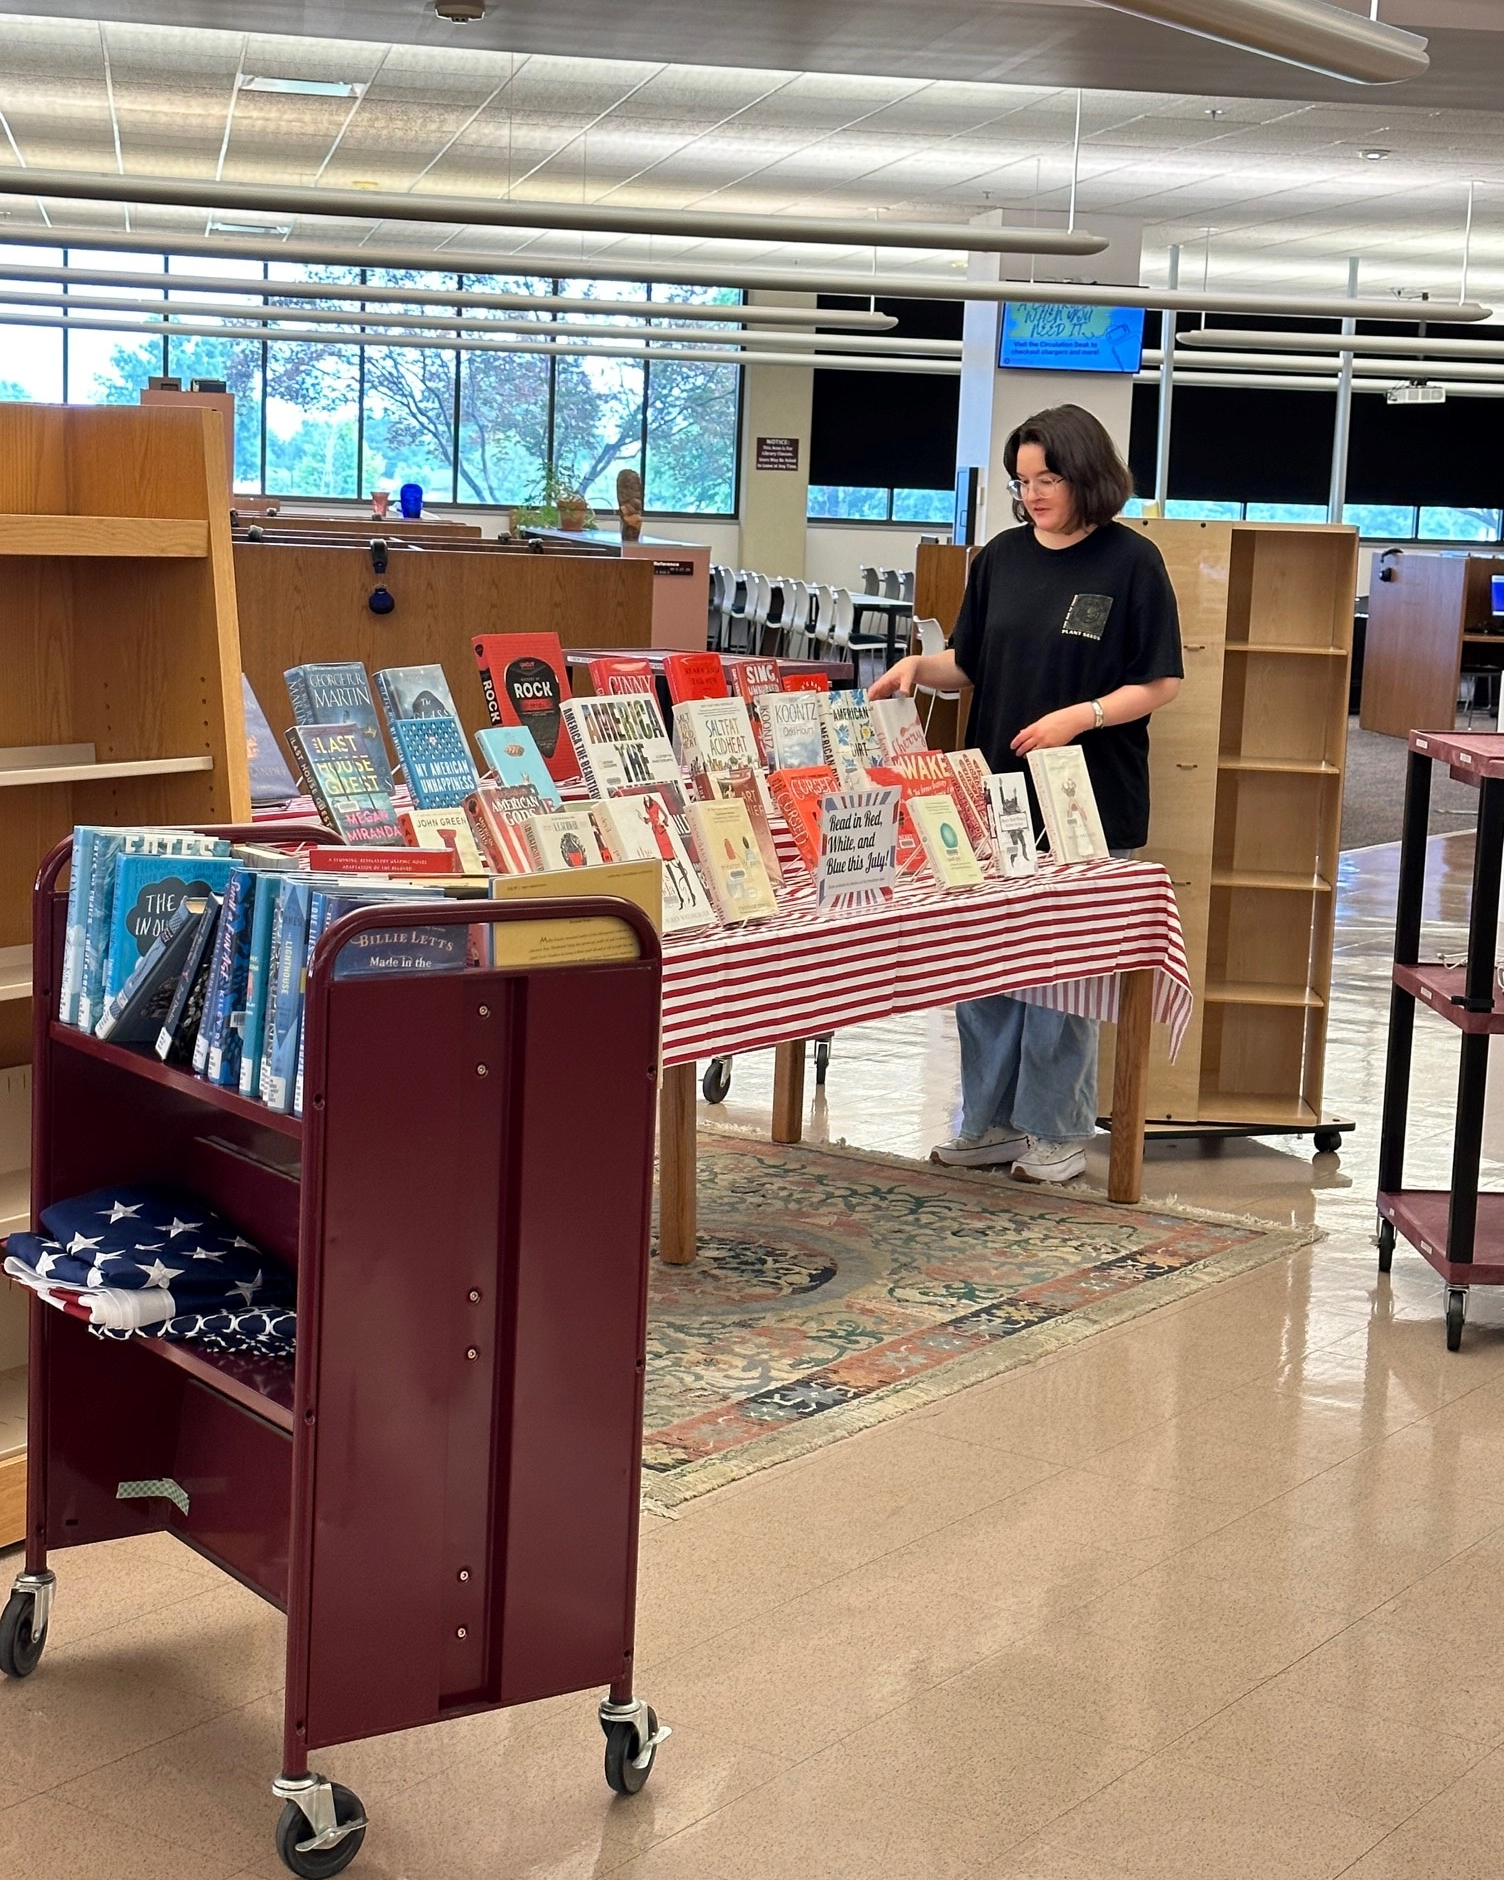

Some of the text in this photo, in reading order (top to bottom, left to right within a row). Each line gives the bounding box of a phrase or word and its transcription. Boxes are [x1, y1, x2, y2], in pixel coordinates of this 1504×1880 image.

[1031, 322, 1083, 338] NEED IT
[1061, 628, 1101, 641] PLANT SEEDS
[309, 674, 345, 687] GEORGE
[513, 681, 553, 699] ROCK
[288, 680, 306, 725] MARTIN
[313, 686, 371, 708] MARTIN
[483, 679, 501, 723] ROCK
[581, 700, 665, 744] AMERICA
[775, 702, 818, 723] KOONTZ
[832, 706, 869, 721] AMERICAN
[705, 720, 725, 737] SALT
[760, 705, 775, 749] KOONTZ
[316, 735, 357, 754] LAST
[709, 735, 748, 756] ACID HEAT
[819, 721, 836, 766] AMERICAN
[850, 742, 869, 758] DIRT
[892, 729, 925, 756] Cherry
[316, 754, 375, 774] HOUSE
[562, 708, 601, 799] AMERICA THE BEAUTIFU
[614, 743, 655, 783] THE
[414, 759, 470, 776] MY AMERICAN
[901, 754, 951, 780] WAKE
[290, 740, 333, 828] LAST HOUSE GUEST
[326, 775, 380, 795] GUEST
[420, 774, 475, 794] UNHAPPINESS
[490, 796, 541, 813] AMERICAN
[417, 817, 467, 828] JOHN GREEN
[502, 808, 537, 827] GODS
[777, 791, 810, 845] CURSED
[829, 809, 883, 832] Read in Red,
[346, 825, 401, 842] MIRANDA
[828, 831, 876, 854] White, and
[827, 849, 890, 876] Blue this July!
[68, 864, 78, 908] LOVE
[145, 892, 177, 914] THE
[135, 916, 152, 936] IN
[308, 901, 319, 957] LOVE LIES
[360, 931, 455, 951] BILLIE LETTS
[281, 941, 293, 995] LIGHTHOUSE
[369, 955, 432, 967] Made in the
[216, 990, 224, 1026] KILEY
